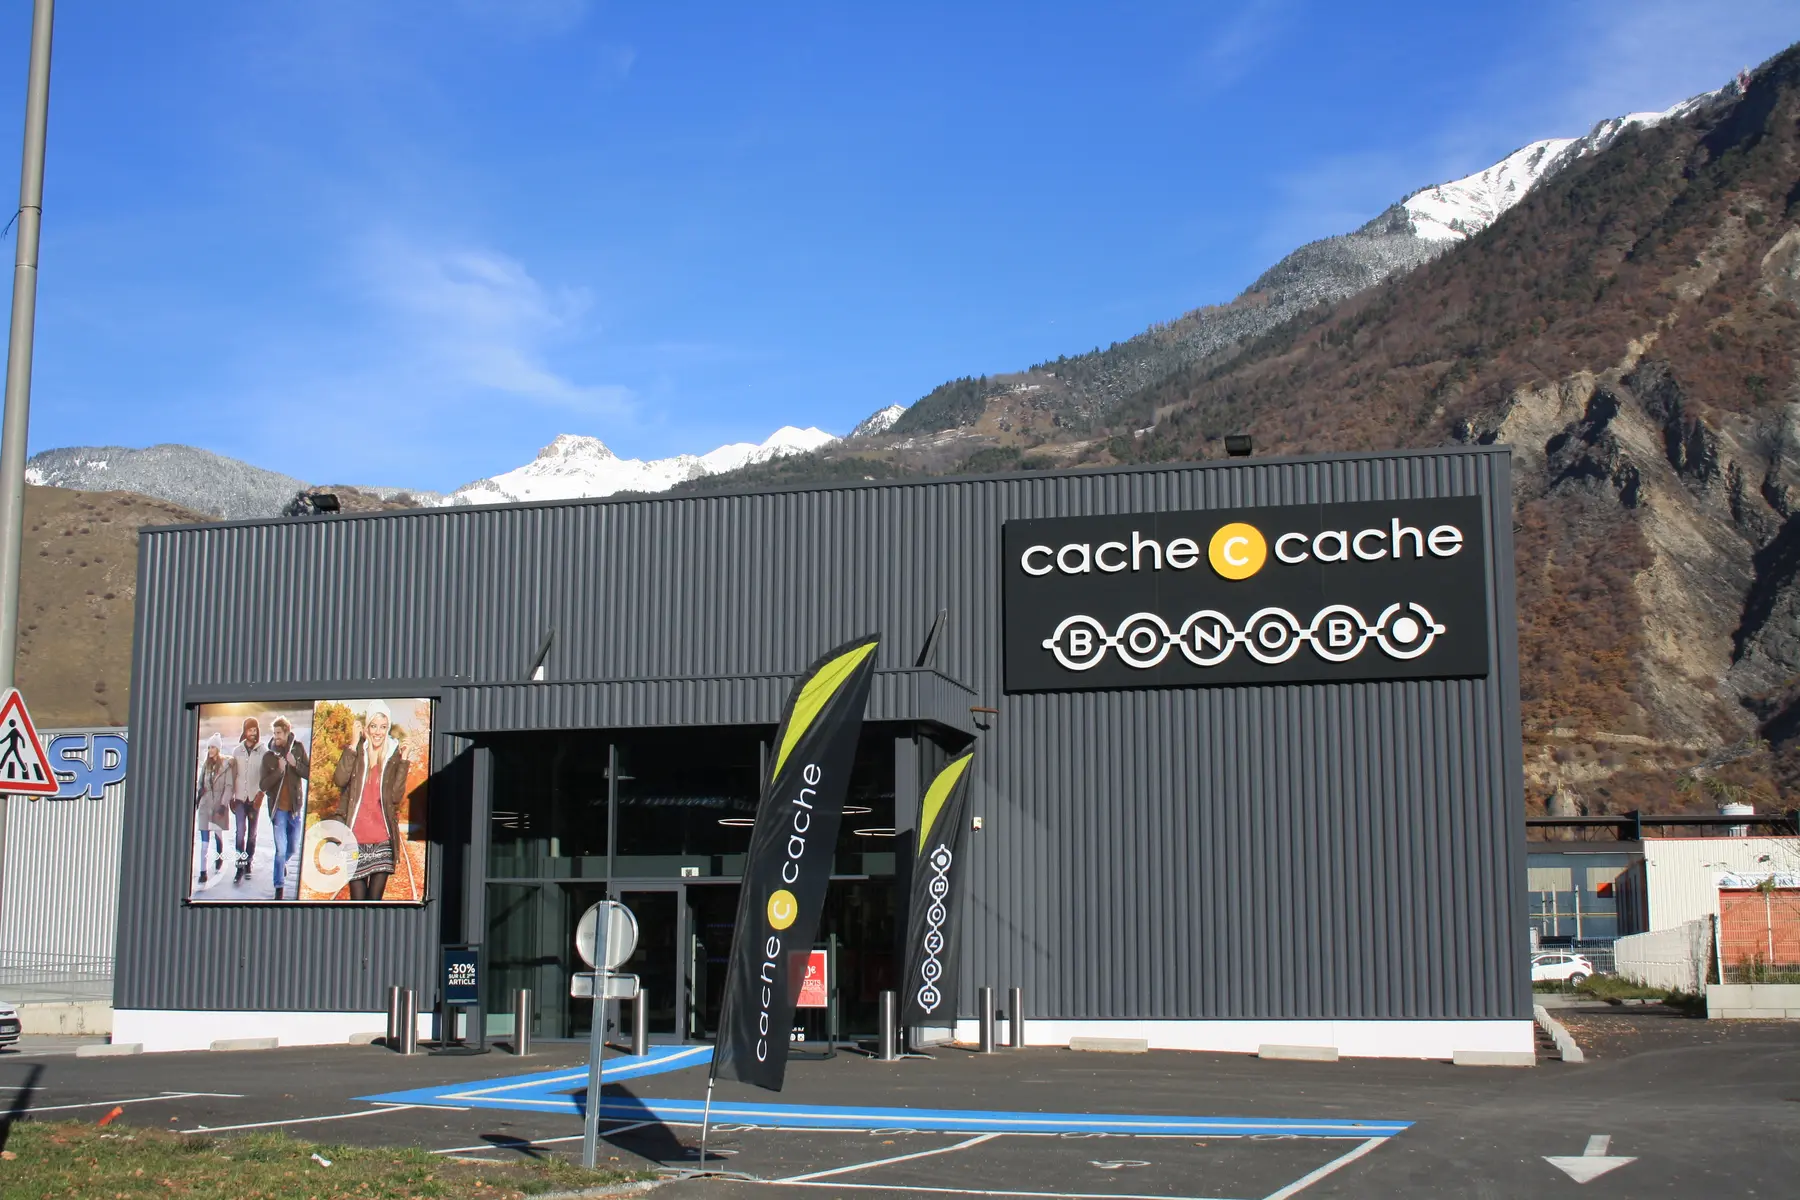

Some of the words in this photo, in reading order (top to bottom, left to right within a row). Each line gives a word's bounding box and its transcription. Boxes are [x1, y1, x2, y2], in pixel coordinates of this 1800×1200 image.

[1021, 531, 1200, 577] cache
[1274, 517, 1464, 564] cache
[1043, 601, 1446, 671] BONOBO
[757, 935, 781, 1062] cache
[782, 763, 821, 884] cache
[917, 844, 953, 1014] BONOBO
[448, 963, 475, 973] -30%
